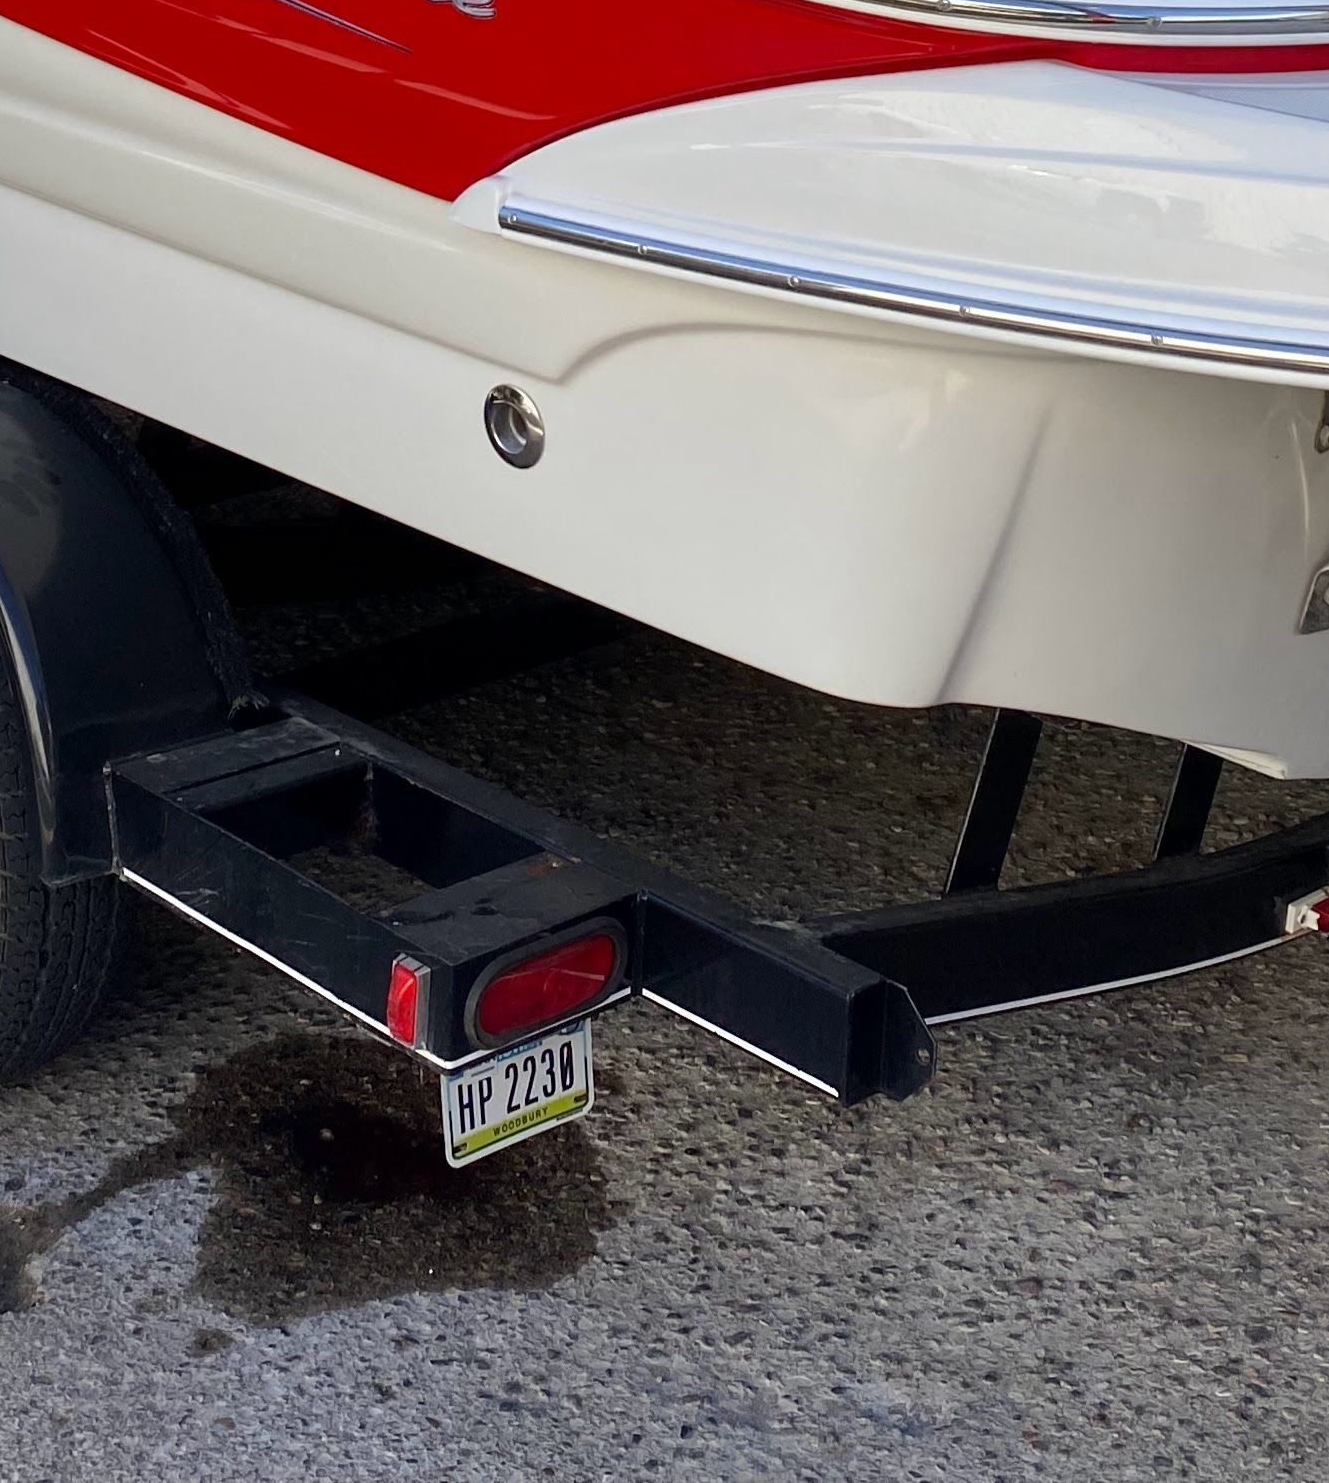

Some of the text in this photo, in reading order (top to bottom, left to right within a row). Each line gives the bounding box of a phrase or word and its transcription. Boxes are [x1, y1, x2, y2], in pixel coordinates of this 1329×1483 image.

[458, 1040, 575, 1134] HP 2230
[493, 1106, 549, 1137] WOODBURY
